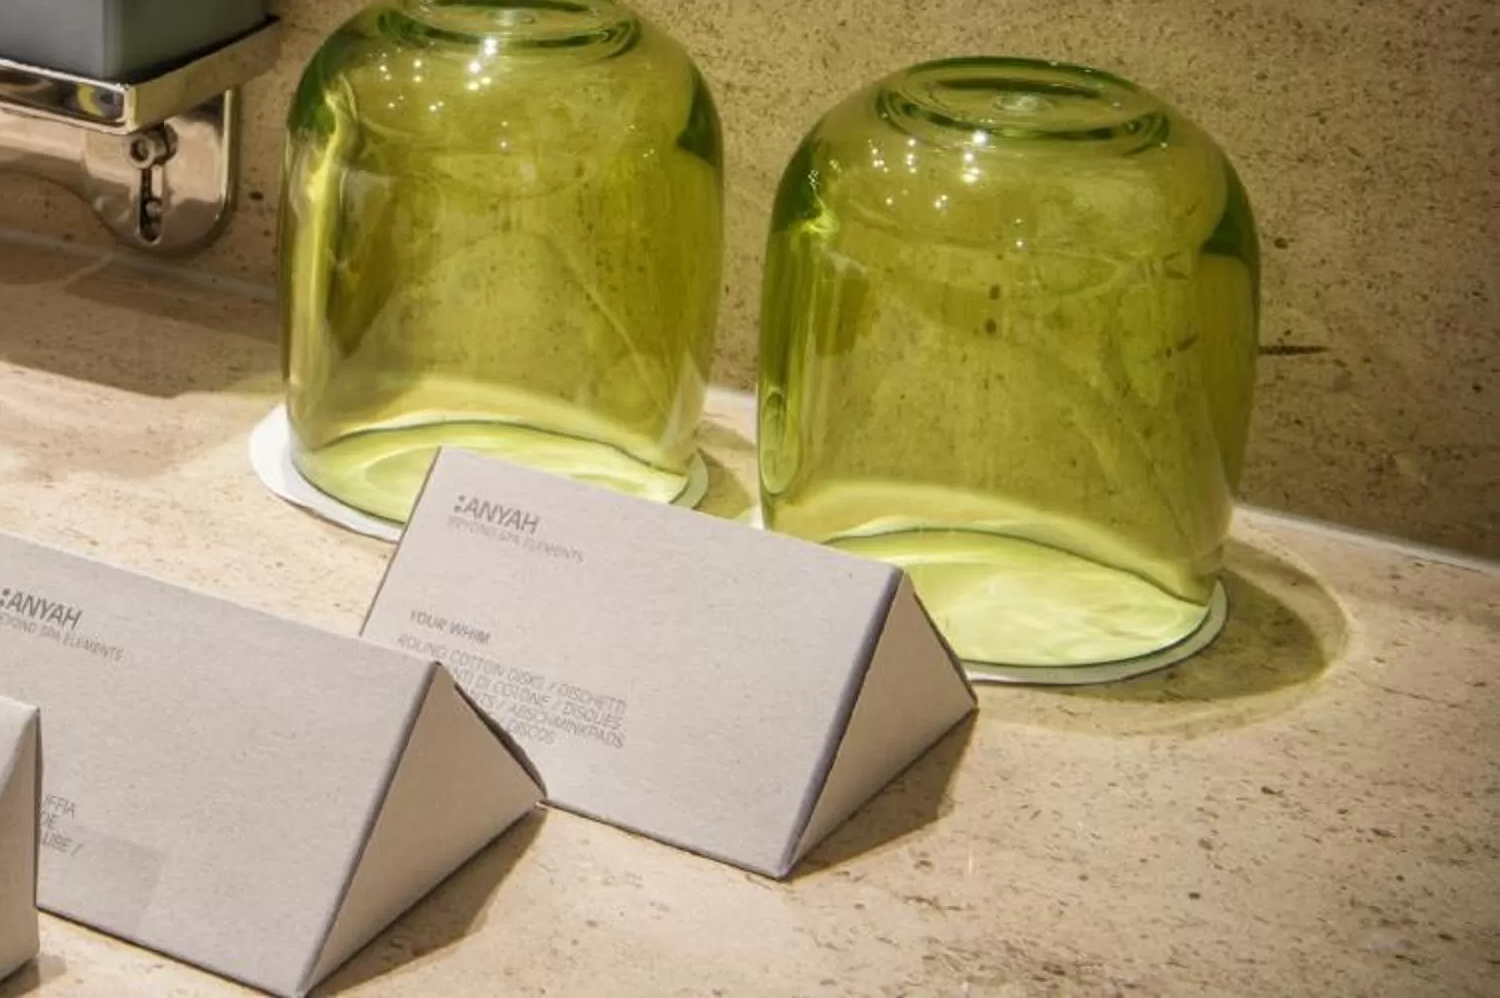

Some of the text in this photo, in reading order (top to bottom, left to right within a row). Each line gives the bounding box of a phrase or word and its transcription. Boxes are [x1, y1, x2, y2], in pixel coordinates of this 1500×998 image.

[409, 608, 491, 644] YOUR WHIM
[62, 632, 126, 663] ELEMENTS
[449, 649, 505, 677] COTTON
